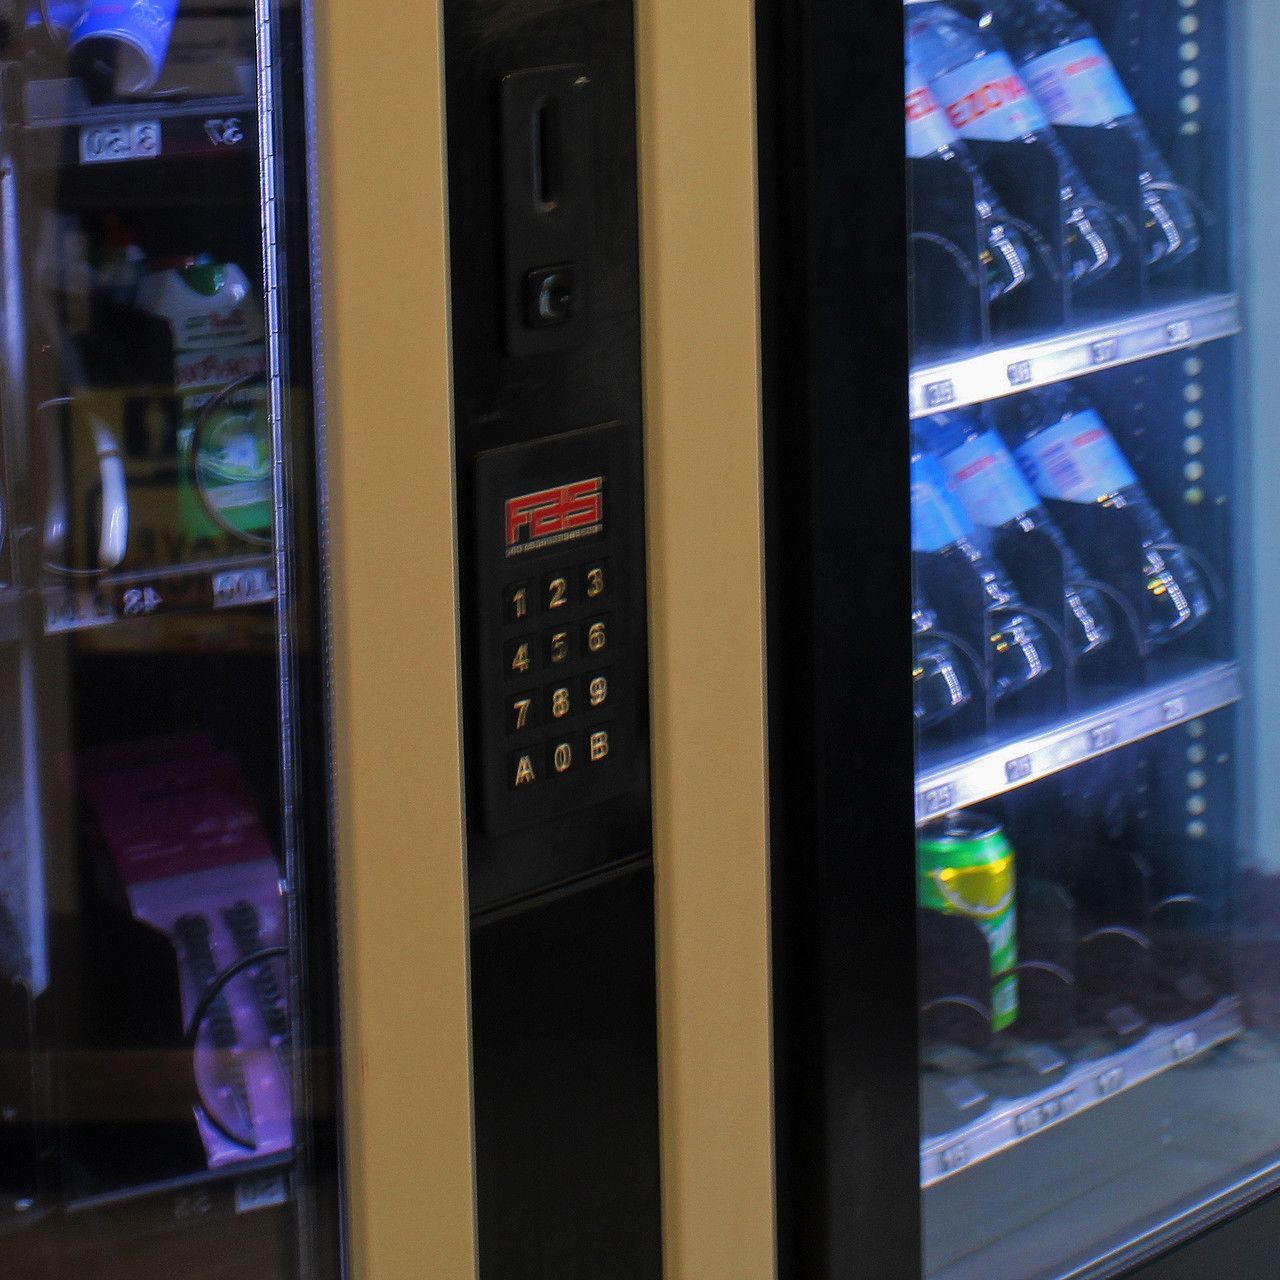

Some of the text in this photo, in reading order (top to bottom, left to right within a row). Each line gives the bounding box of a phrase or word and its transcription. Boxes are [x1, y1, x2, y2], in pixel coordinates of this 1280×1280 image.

[513, 567, 604, 619] 1 2 3
[511, 622, 606, 674] 4 5 6
[513, 676, 608, 730] 7 8 9
[514, 754, 535, 787] A
[590, 731, 610, 762] B
